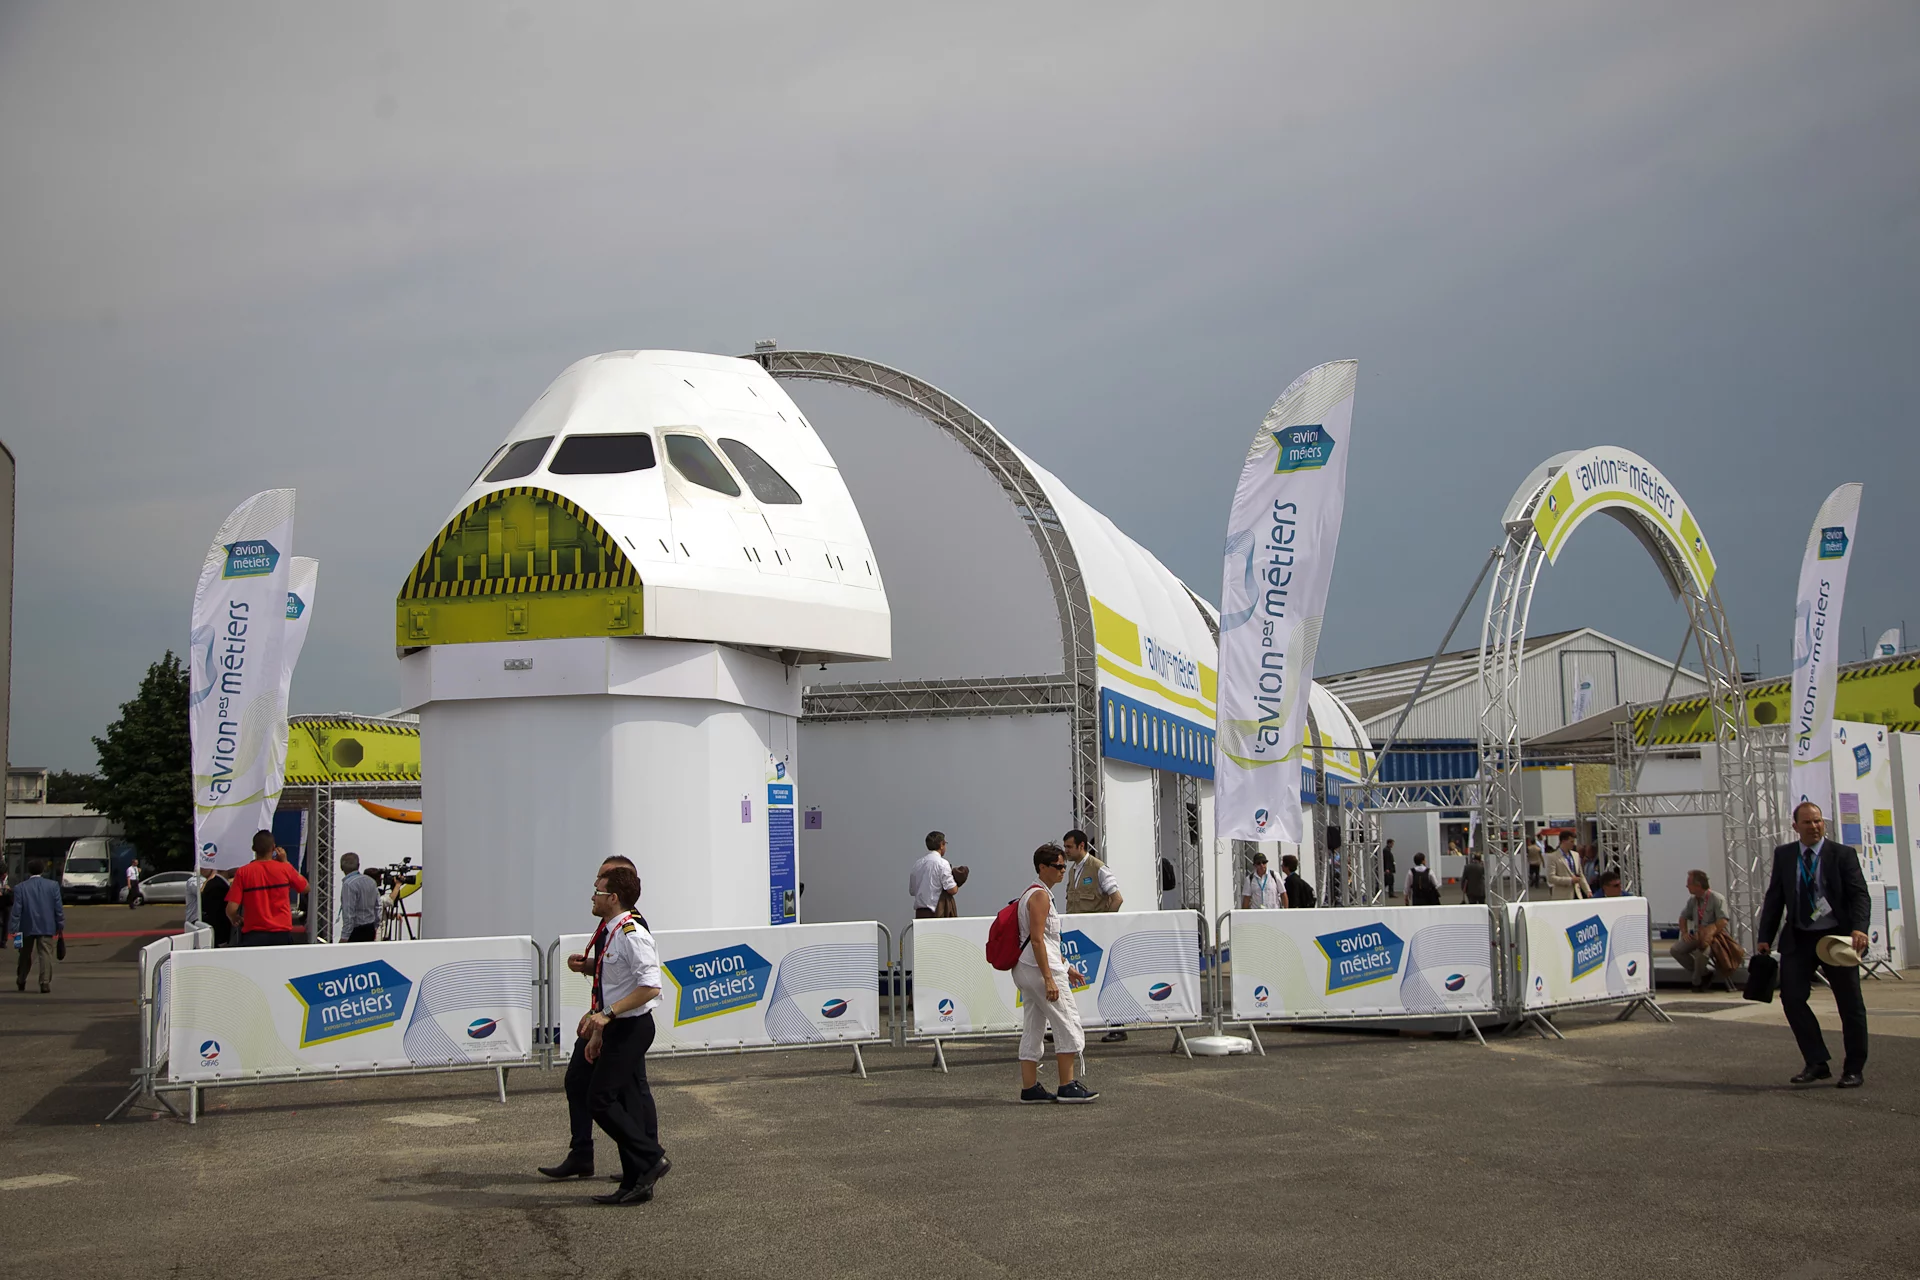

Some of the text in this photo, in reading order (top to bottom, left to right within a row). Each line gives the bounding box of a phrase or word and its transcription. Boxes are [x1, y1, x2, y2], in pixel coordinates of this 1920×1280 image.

[1630, 464, 1675, 518] métiers
[233, 557, 270, 569] métiers
[1262, 499, 1297, 618] métiers
[1812, 578, 1830, 663] métiers
[220, 600, 249, 694] métiers
[811, 816, 816, 824] 2
[1340, 951, 1391, 975] métiers
[692, 975, 755, 1004] métiers
[321, 993, 393, 1024] métiers
